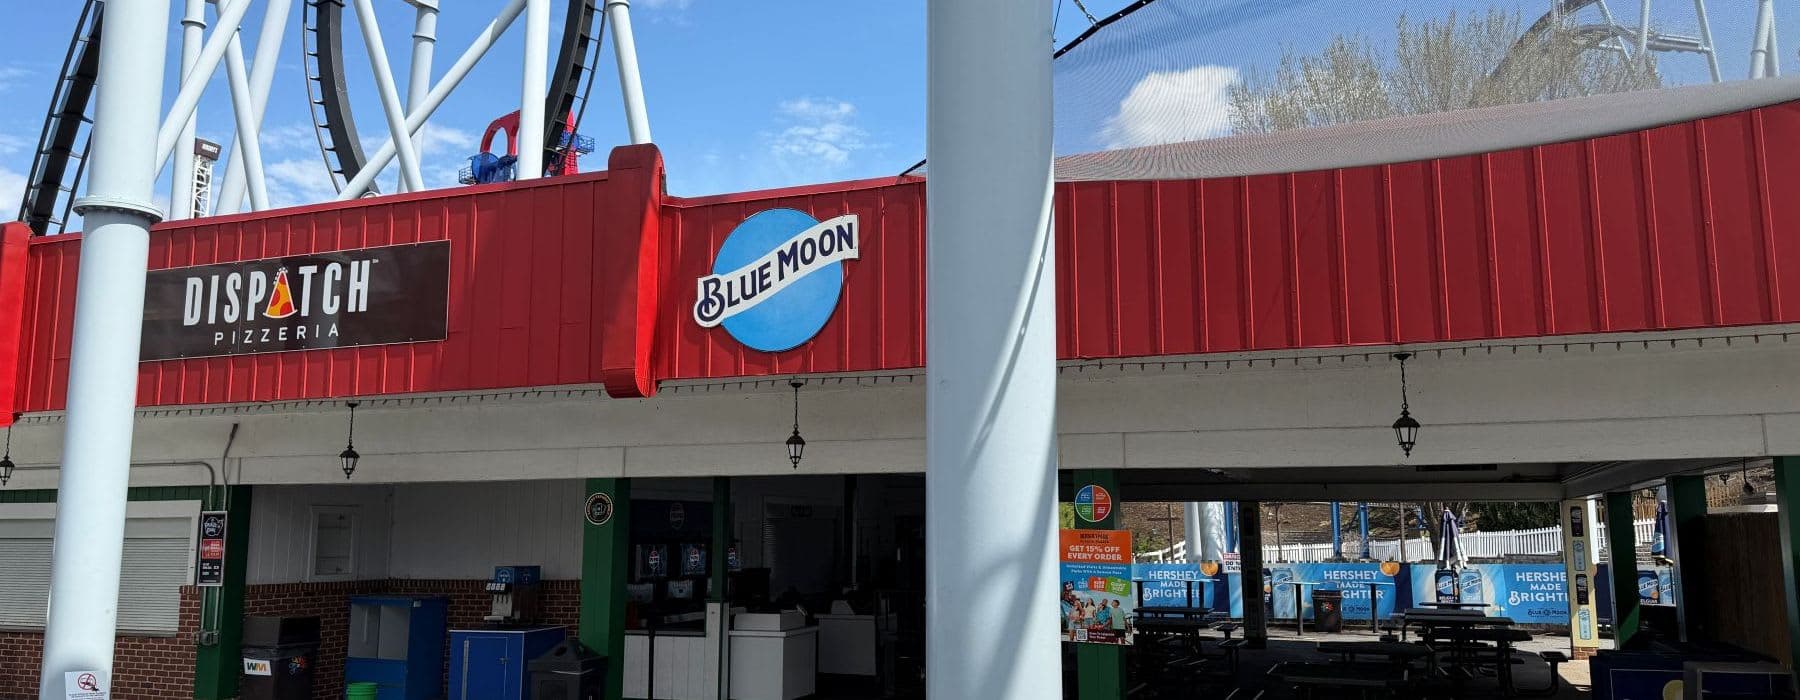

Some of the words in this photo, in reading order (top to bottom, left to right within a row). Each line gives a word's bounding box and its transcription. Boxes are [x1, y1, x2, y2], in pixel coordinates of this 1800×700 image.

[697, 261, 772, 322] BLUE
[776, 222, 854, 282] MOON
[184, 260, 371, 326] DISPATCH
[214, 322, 339, 346] PIZZERIA
[1086, 545, 1103, 553] 15%
[1067, 552, 1093, 560] EVERY
[1094, 553, 1122, 561] ORDER
[1148, 570, 1199, 580] HERSHEY
[1323, 570, 1378, 580] HERSHEY
[1516, 571, 1567, 582] HERSHE
[1160, 580, 1187, 588] MADE
[1530, 583, 1561, 591] MADE
[246, 661, 267, 672] WM
